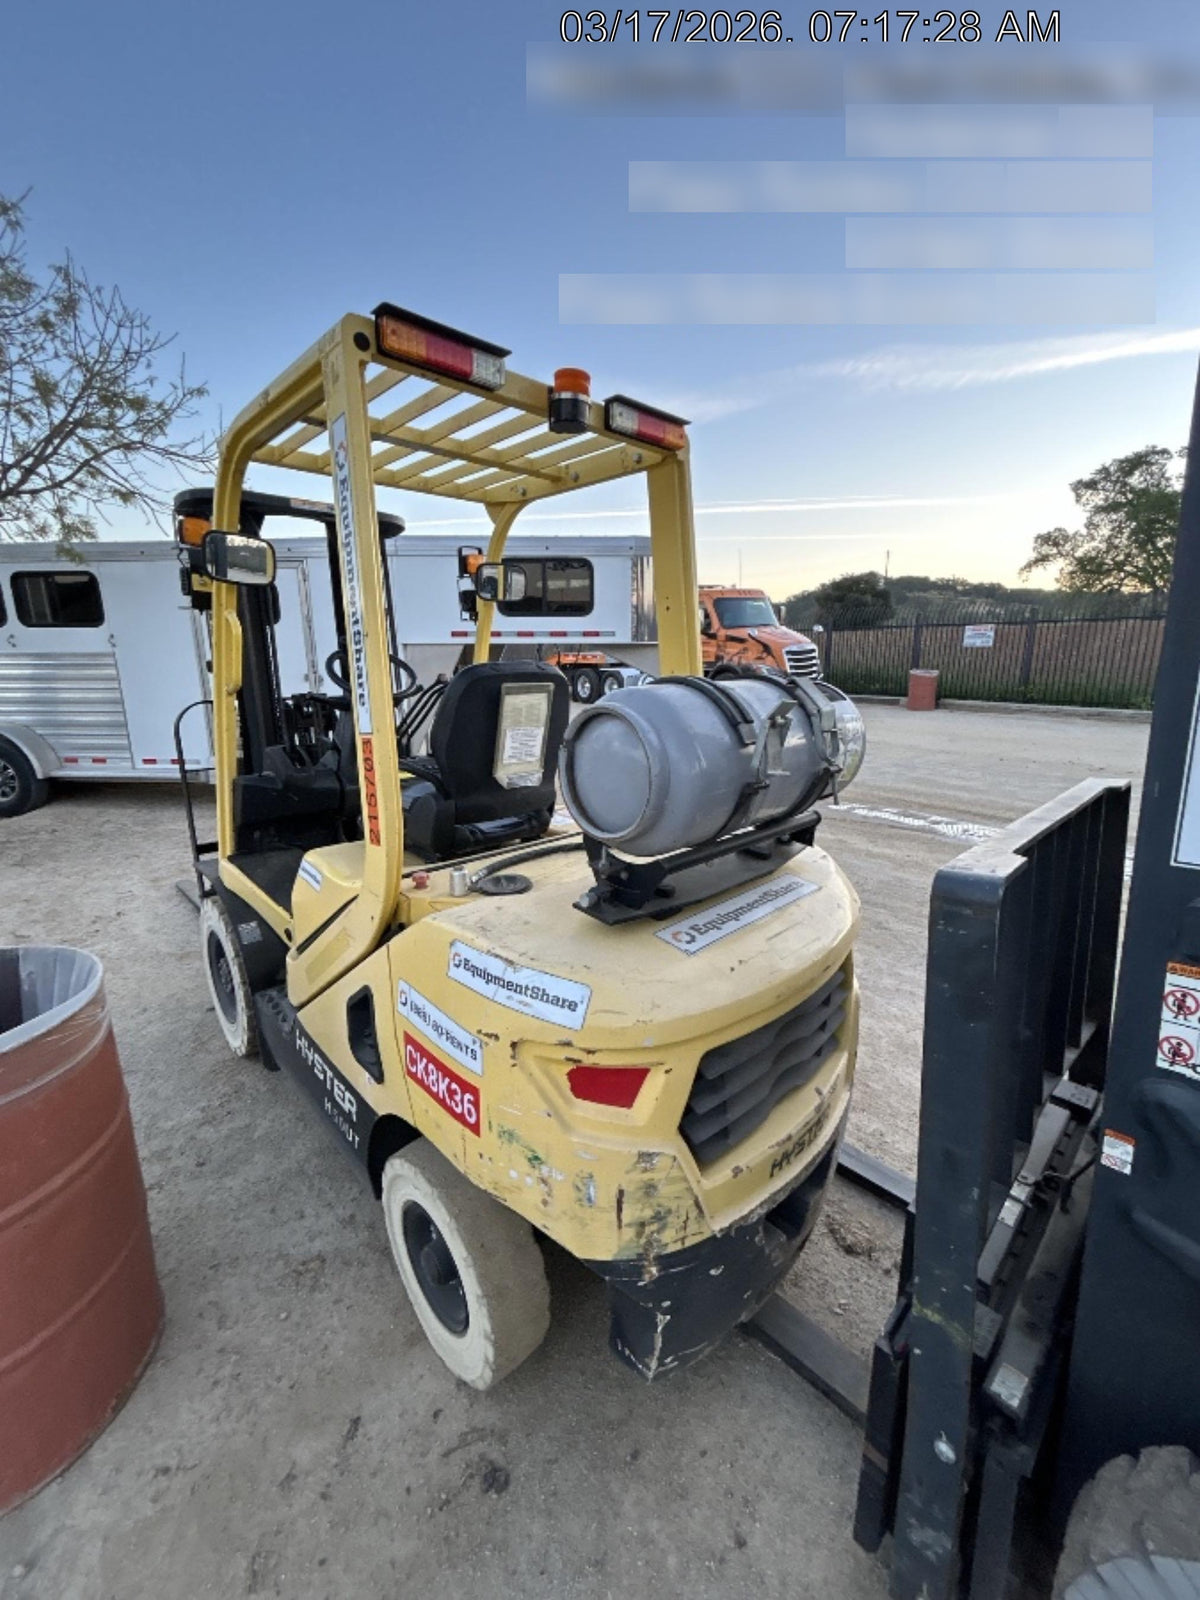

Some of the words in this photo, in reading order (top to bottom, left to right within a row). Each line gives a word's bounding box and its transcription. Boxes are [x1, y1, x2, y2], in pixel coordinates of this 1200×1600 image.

[338, 474, 367, 707] EquipmentShare
[362, 738, 380, 847] 215703
[692, 879, 805, 937] EquipmentShare
[463, 957, 579, 1014] EquipmentShare
[296, 1028, 357, 1122] HYSTER
[405, 1044, 478, 1126] CK8K36
